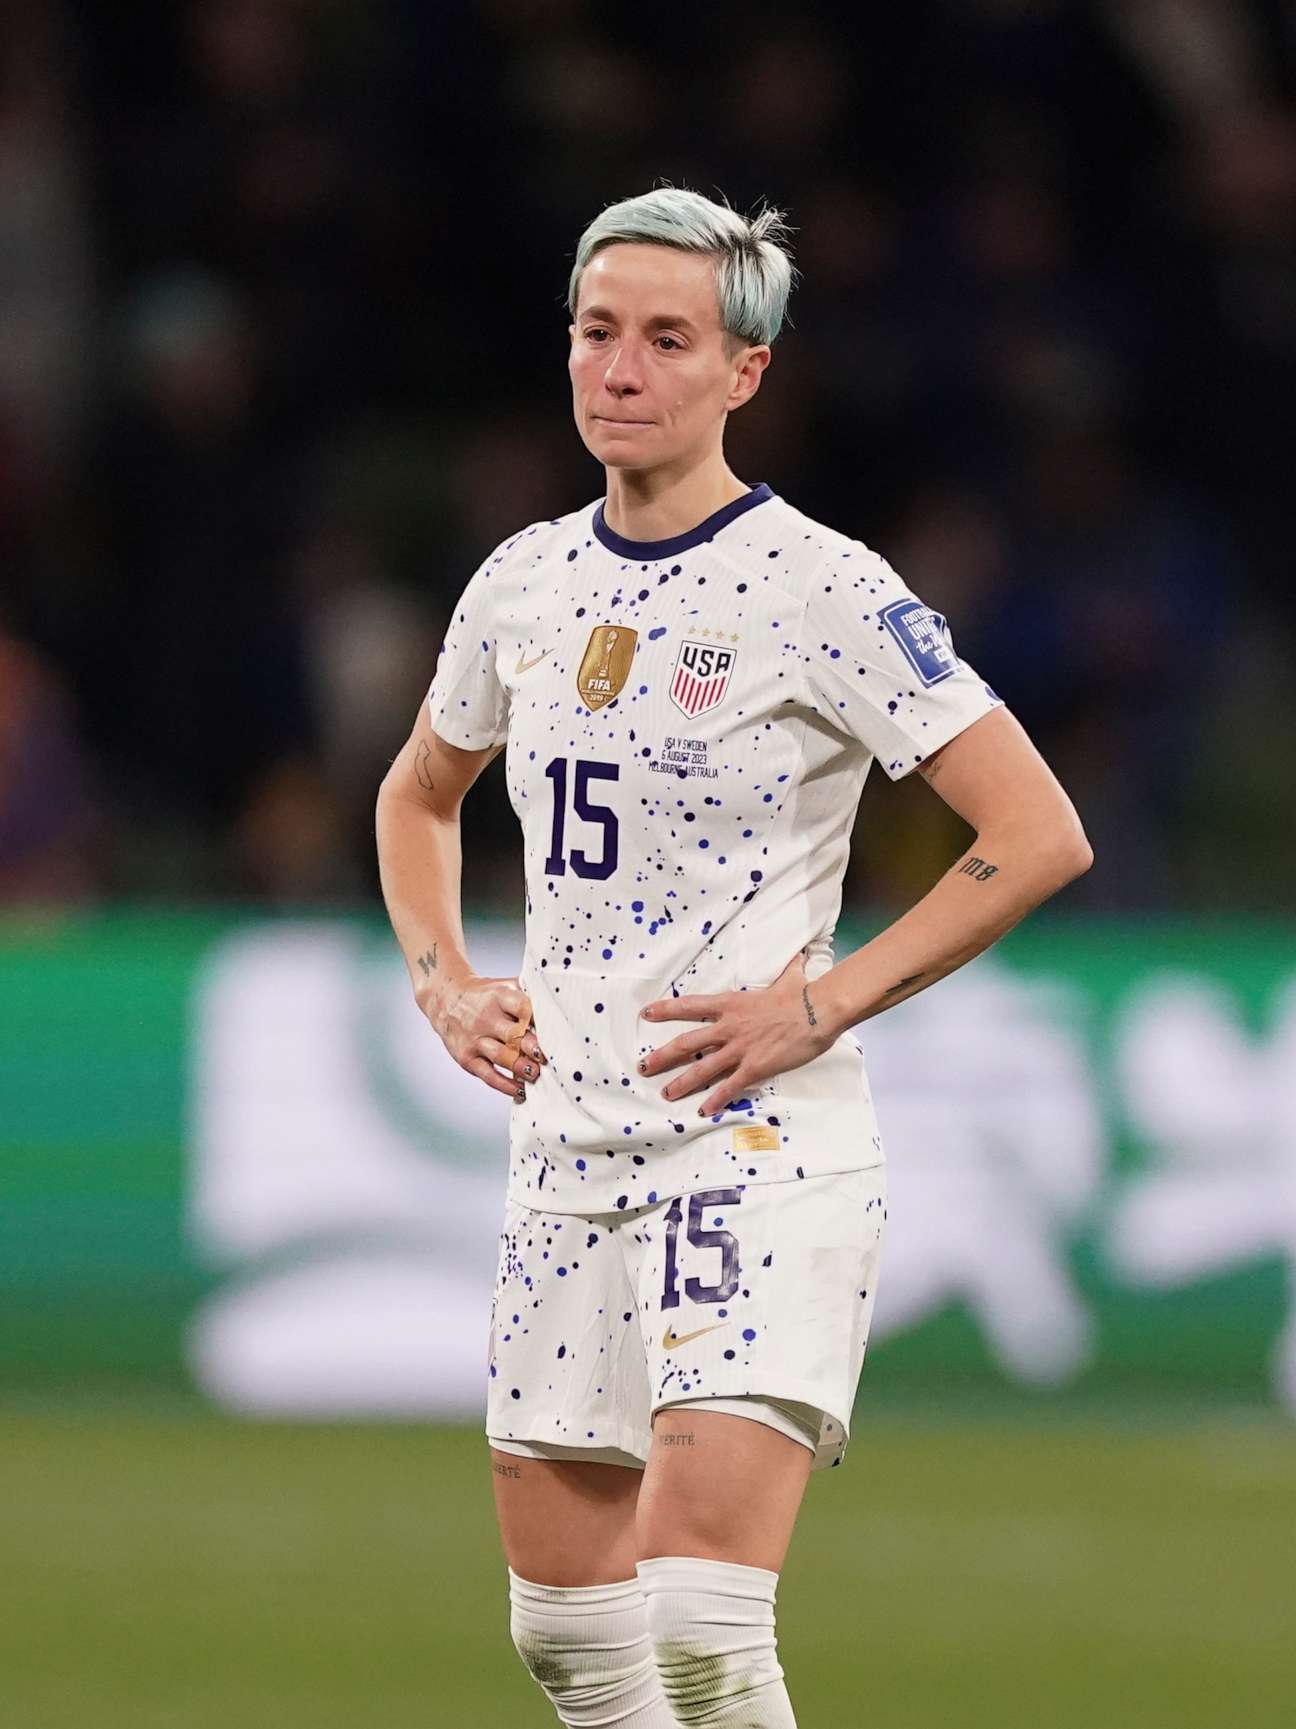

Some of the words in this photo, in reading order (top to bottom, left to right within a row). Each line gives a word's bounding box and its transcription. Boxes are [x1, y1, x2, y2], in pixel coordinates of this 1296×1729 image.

[682, 645, 732, 678] USA
[587, 678, 611, 691] FIFA
[664, 736, 676, 748] USA
[683, 739, 708, 753] SWEDEN
[667, 750, 691, 763] AUGUST
[691, 753, 708, 765] 2023
[544, 757, 620, 881] 15
[660, 1188, 742, 1312] 15
